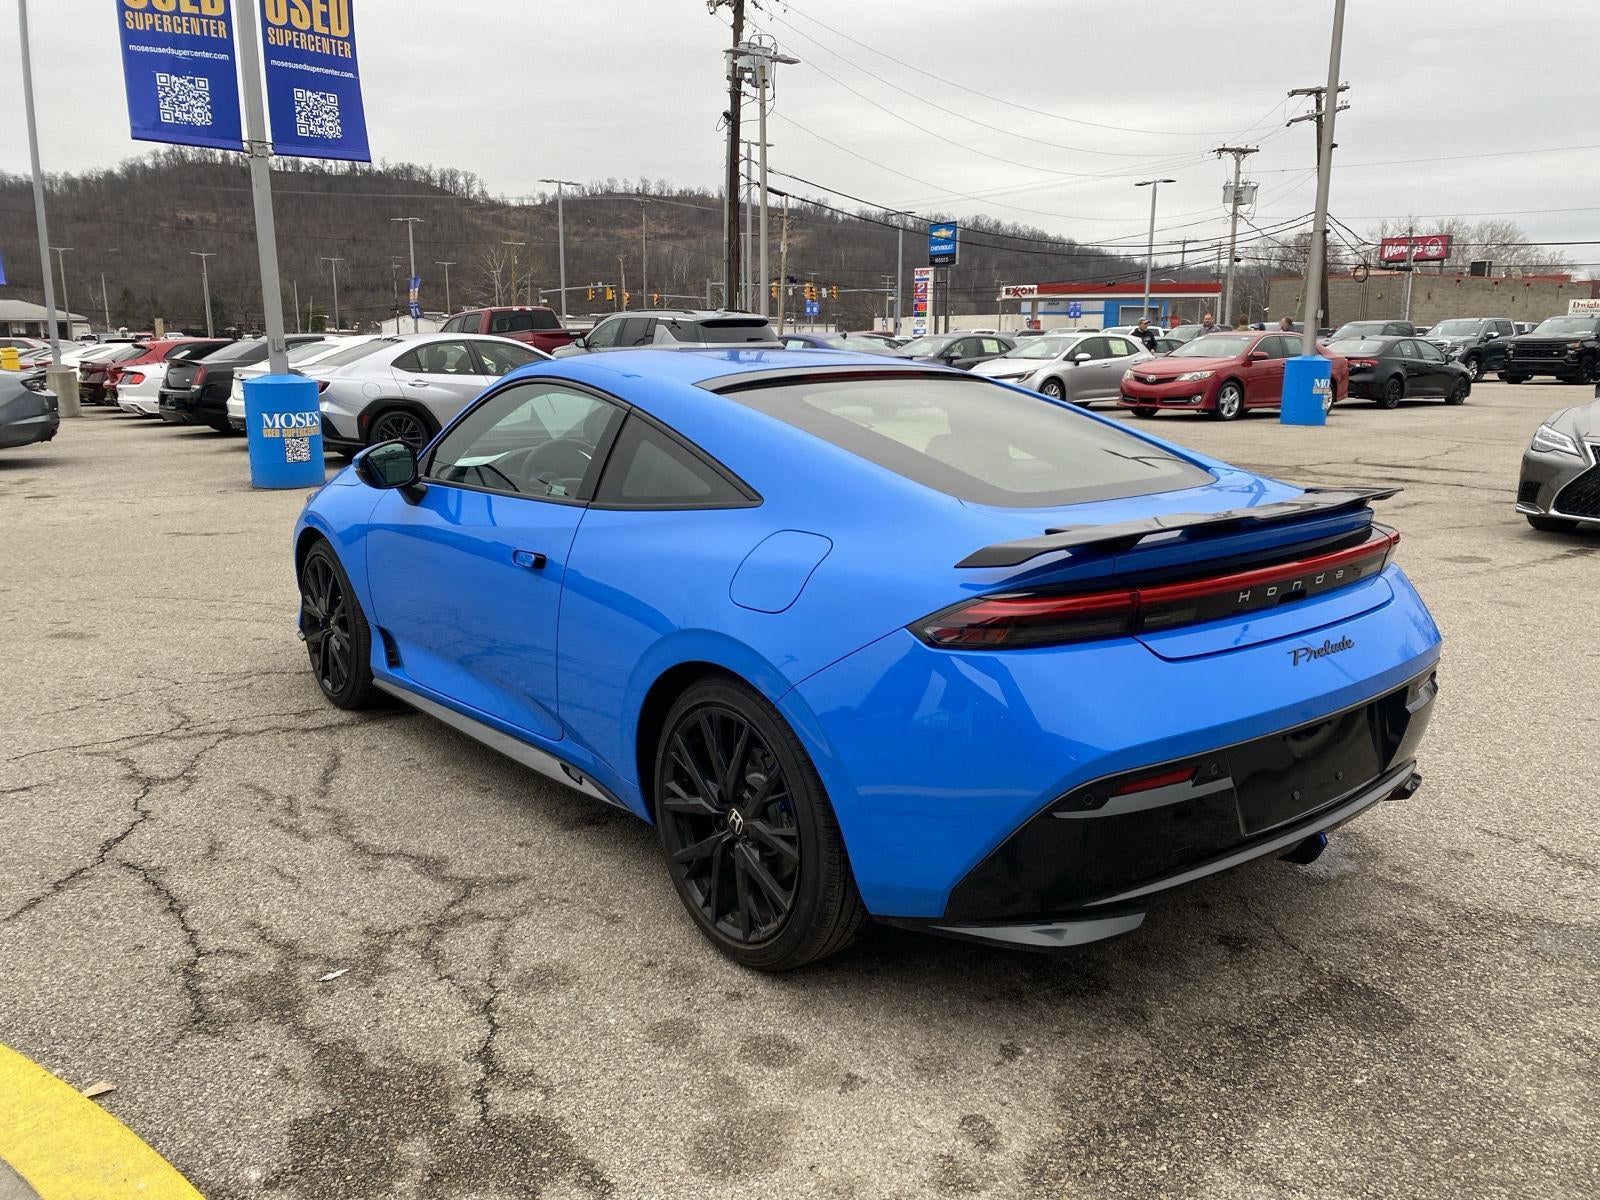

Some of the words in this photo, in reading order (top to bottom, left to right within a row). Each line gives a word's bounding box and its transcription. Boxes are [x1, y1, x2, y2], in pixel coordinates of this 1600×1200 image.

[124, 11, 227, 39] SUPERCENTER
[129, 44, 229, 60] mosesusedsupercenter.com
[267, 27, 352, 59] SUPERCENTER
[270, 59, 354, 79] mosesusedsupercenter.com
[1005, 287, 1035, 297] EXXON
[261, 411, 320, 429] MOSES
[1238, 569, 1345, 603] Honda
[1287, 634, 1355, 667] Prelude
